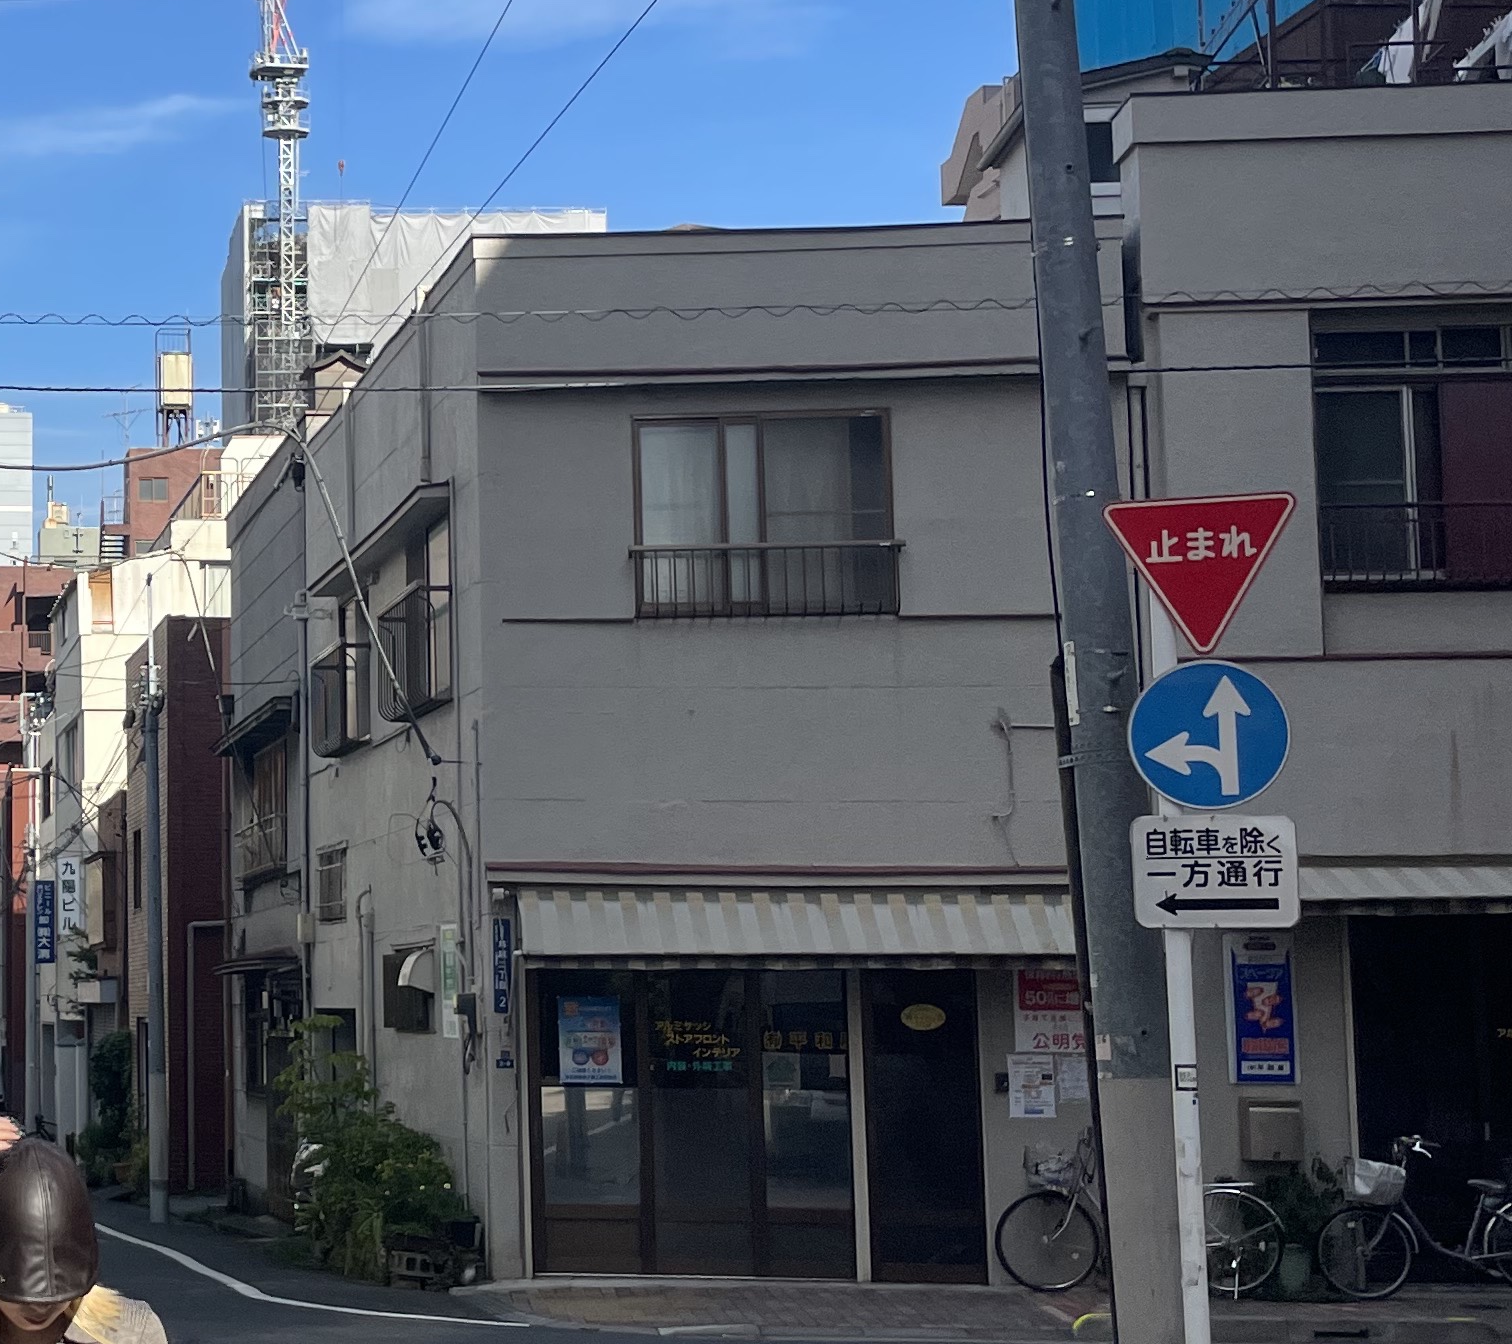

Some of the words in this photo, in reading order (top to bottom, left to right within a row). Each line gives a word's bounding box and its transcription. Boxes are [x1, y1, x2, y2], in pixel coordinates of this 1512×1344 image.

[1145, 525, 1258, 564] 止まれ
[1145, 827, 1283, 856] 自転車を除く
[1145, 859, 1284, 888] 一方通行
[499, 996, 507, 1008] 2
[665, 1034, 730, 1046] ストアフロント
[1032, 1032, 1086, 1050] 公明党
[692, 1047, 741, 1058] インテリア
